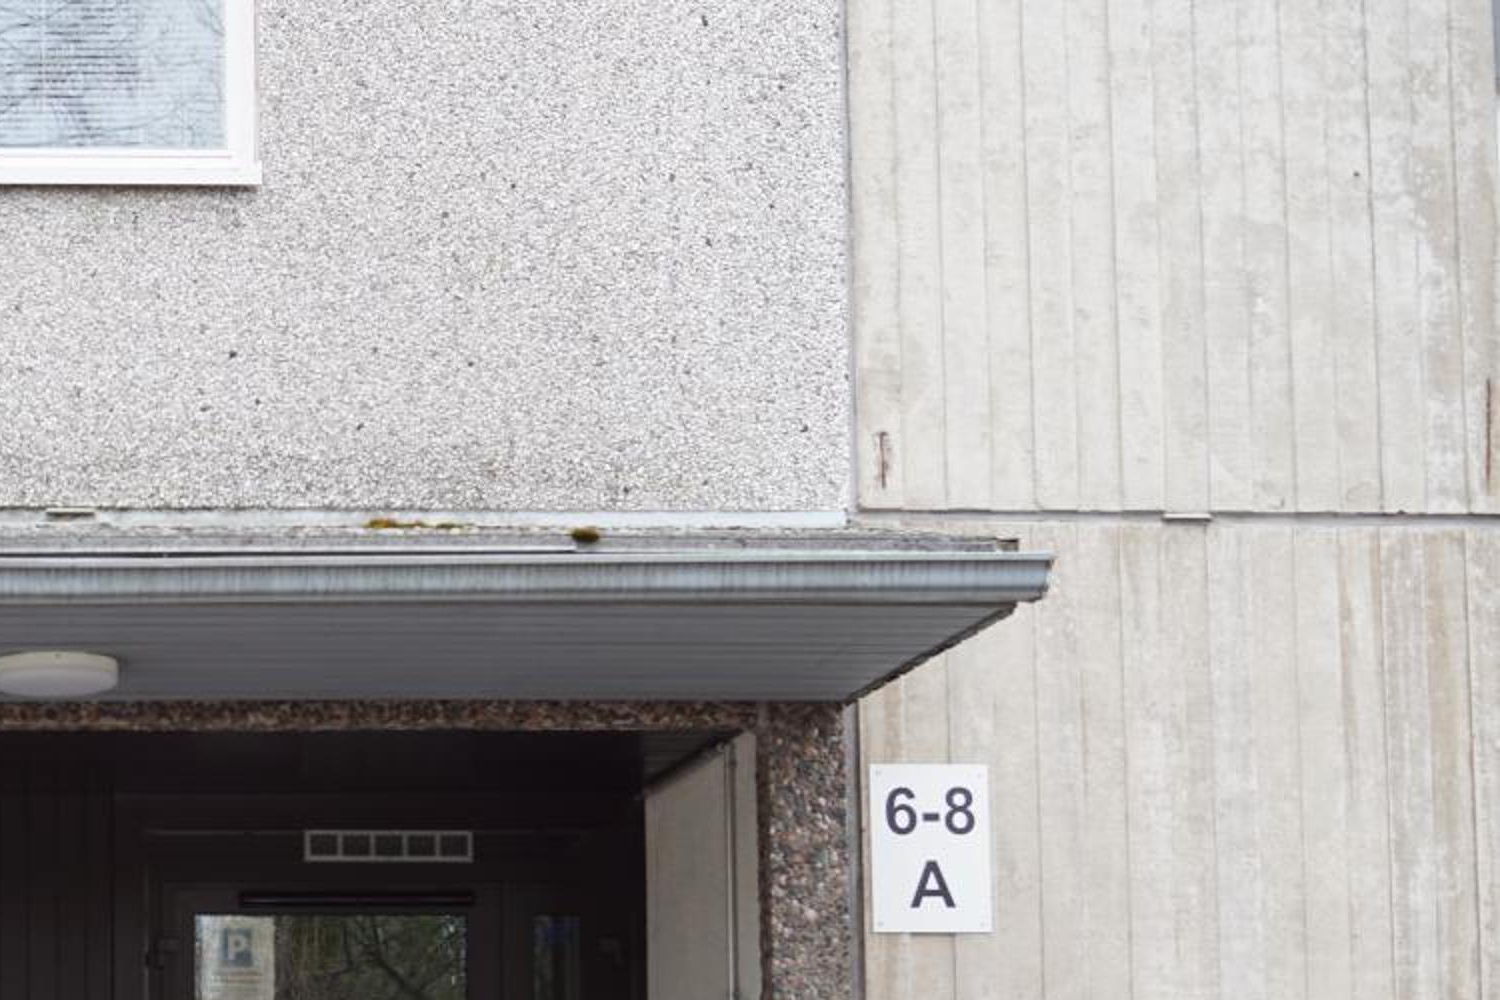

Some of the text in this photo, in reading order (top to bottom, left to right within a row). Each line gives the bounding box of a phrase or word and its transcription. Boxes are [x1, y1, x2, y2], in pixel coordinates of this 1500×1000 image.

[886, 787, 975, 835] 6-8
[910, 860, 956, 908] A
[227, 934, 248, 961] P
